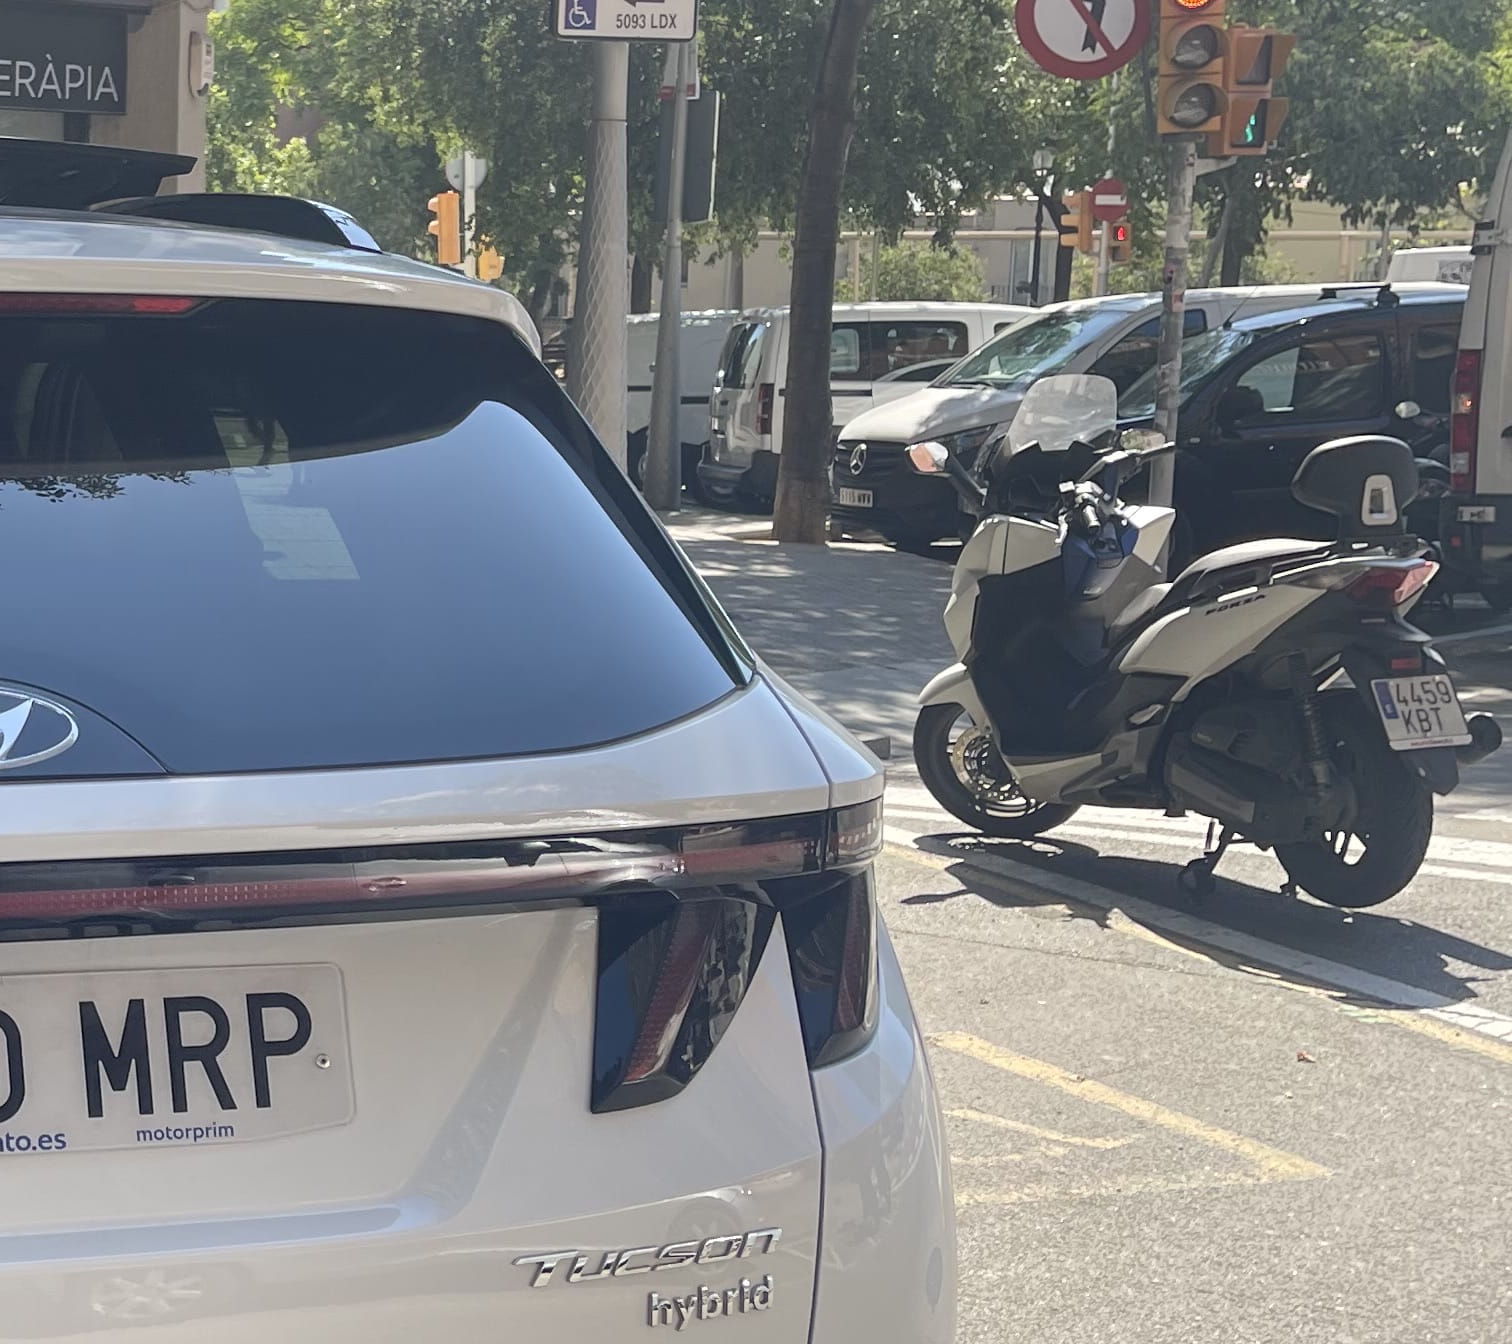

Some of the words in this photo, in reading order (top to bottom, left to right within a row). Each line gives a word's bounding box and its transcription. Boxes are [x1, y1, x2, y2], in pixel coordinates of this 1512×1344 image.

[616, 13, 646, 29] 5093
[651, 13, 677, 29] LDX
[1395, 680, 1452, 707] 4459
[1401, 706, 1444, 735] KBT
[78, 991, 313, 1119] MRP
[136, 1121, 235, 1143] motorprim
[512, 1226, 783, 1288] TUCSON
[648, 1273, 774, 1331] hybrid
